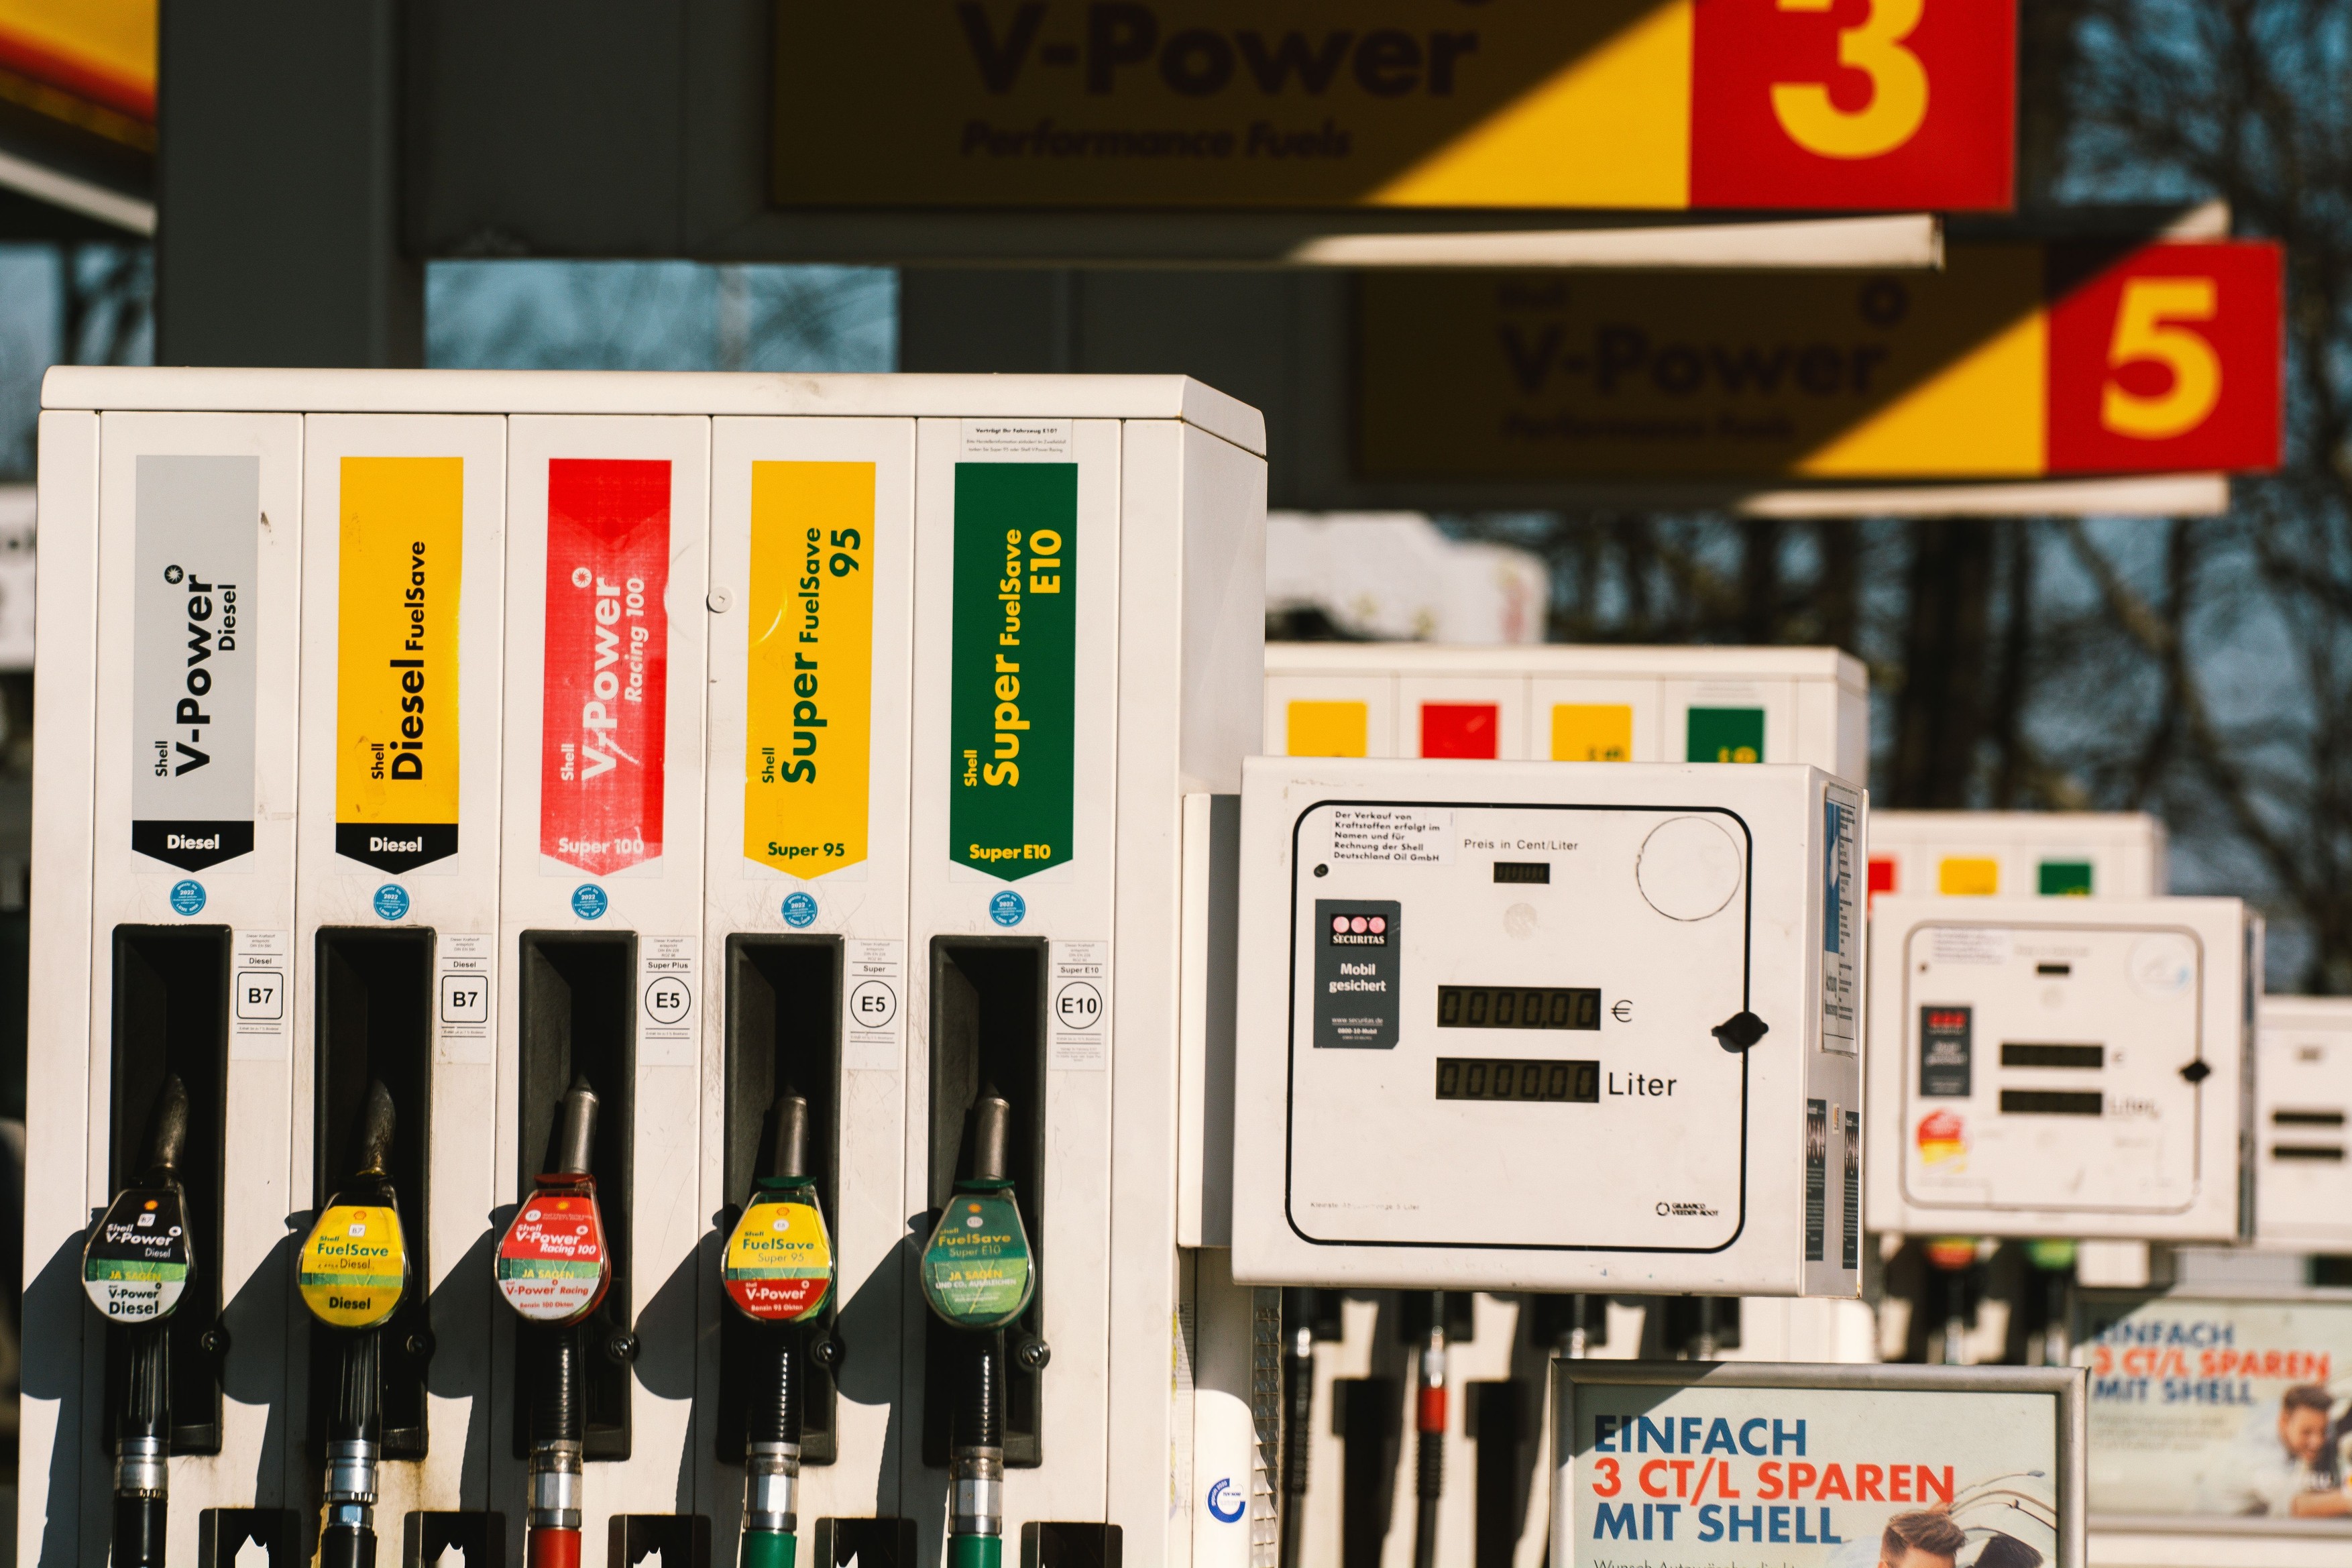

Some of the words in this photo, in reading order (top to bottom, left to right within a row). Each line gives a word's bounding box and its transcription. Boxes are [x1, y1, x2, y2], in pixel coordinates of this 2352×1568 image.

[956, 0, 1479, 97] V-Power
[1771, 0, 1929, 160] 3
[961, 119, 1235, 160] Performance
[1248, 119, 1350, 159] Fuels
[2103, 276, 2223, 441] 5
[830, 528, 861, 577] 95
[1029, 529, 1062, 594] E10
[799, 527, 821, 643] FuelSave
[999, 529, 1021, 647] FuelSave
[406, 541, 426, 651] FuelSave
[626, 577, 645, 616] 100
[218, 584, 236, 651] Diesel
[624, 626, 649, 703] Racing
[176, 574, 213, 777] V-Power
[581, 577, 621, 781] V-Power
[390, 659, 425, 780] Diesel
[781, 653, 828, 785] Super
[983, 654, 1030, 787] Super
[156, 741, 168, 777] Shell
[372, 743, 385, 779] Shell
[561, 743, 575, 781] Shell
[762, 747, 775, 783] Shell
[964, 749, 977, 786] Shell
[1335, 822, 1390, 830] Kraftstoffen
[1394, 824, 1425, 832] erfolgt
[167, 834, 219, 850] Diesel
[370, 836, 423, 852] Diesel
[559, 838, 610, 856] Super
[614, 838, 644, 854] 100
[767, 842, 819, 858] Super
[823, 842, 845, 856] 95
[1334, 842, 1379, 851] Rechnung
[1382, 842, 1398, 850] der
[1402, 843, 1424, 851] Shell
[1464, 838, 1494, 849] Preis
[1501, 839, 1510, 849] in
[1516, 840, 1578, 850] Cent/Liter
[970, 844, 1021, 860] Super
[1023, 844, 1051, 859] E10
[1334, 852, 1390, 860] Deutschland
[1333, 935, 1385, 944] SECURITAS
[864, 965, 885, 973] Super
[1341, 963, 1376, 976] Mobil
[1329, 979, 1386, 993] gesichert
[249, 988, 274, 1003] B7
[453, 991, 478, 1007] B7
[657, 993, 680, 1008] E5
[862, 996, 885, 1012] E5
[1062, 997, 1097, 1013] E10
[1611, 999, 1633, 1023] €
[1609, 1072, 1677, 1096] Liter
[107, 1223, 134, 1233] Shell
[518, 1224, 543, 1232] Shell
[106, 1232, 174, 1246] V-Power
[516, 1231, 580, 1245] V-Power
[743, 1239, 814, 1249] FuelSave
[938, 1233, 1011, 1246] FuelSave
[144, 1247, 171, 1258] Diesel
[317, 1243, 388, 1257] FuelSave
[541, 1243, 575, 1256] Racing
[577, 1245, 596, 1255] 100
[950, 1247, 977, 1257] Super
[981, 1245, 1001, 1255] E10
[340, 1258, 371, 1269] Diesel
[758, 1253, 787, 1264] Super
[791, 1253, 804, 1262] 95
[109, 1270, 121, 1280] JA
[522, 1270, 535, 1278] JA
[539, 1270, 575, 1279] SAGEN
[948, 1272, 962, 1281] JA
[965, 1270, 1003, 1280] SAGEN
[109, 1288, 159, 1299] V-Power
[506, 1286, 555, 1296] V-Power
[560, 1286, 589, 1296] Racing
[746, 1288, 805, 1300] V-Power
[109, 1300, 159, 1314] Diesel
[329, 1296, 371, 1310] Diesel
[2094, 1321, 2236, 1346] EINFACH
[2094, 1345, 2113, 1376] 3
[2122, 1345, 2190, 1381] CT/L
[2200, 1347, 2331, 1382] SPAREN
[2095, 1379, 2147, 1403] MIT
[2164, 1379, 2256, 1406] SHELL
[1595, 1414, 1806, 1456] EINFACH
[1592, 1457, 1622, 1498] 3
[1638, 1457, 1740, 1506] CT/L
[1756, 1461, 1954, 1503] SPAREN
[1593, 1502, 1681, 1541] MIT
[1697, 1504, 1842, 1544] SHELL
